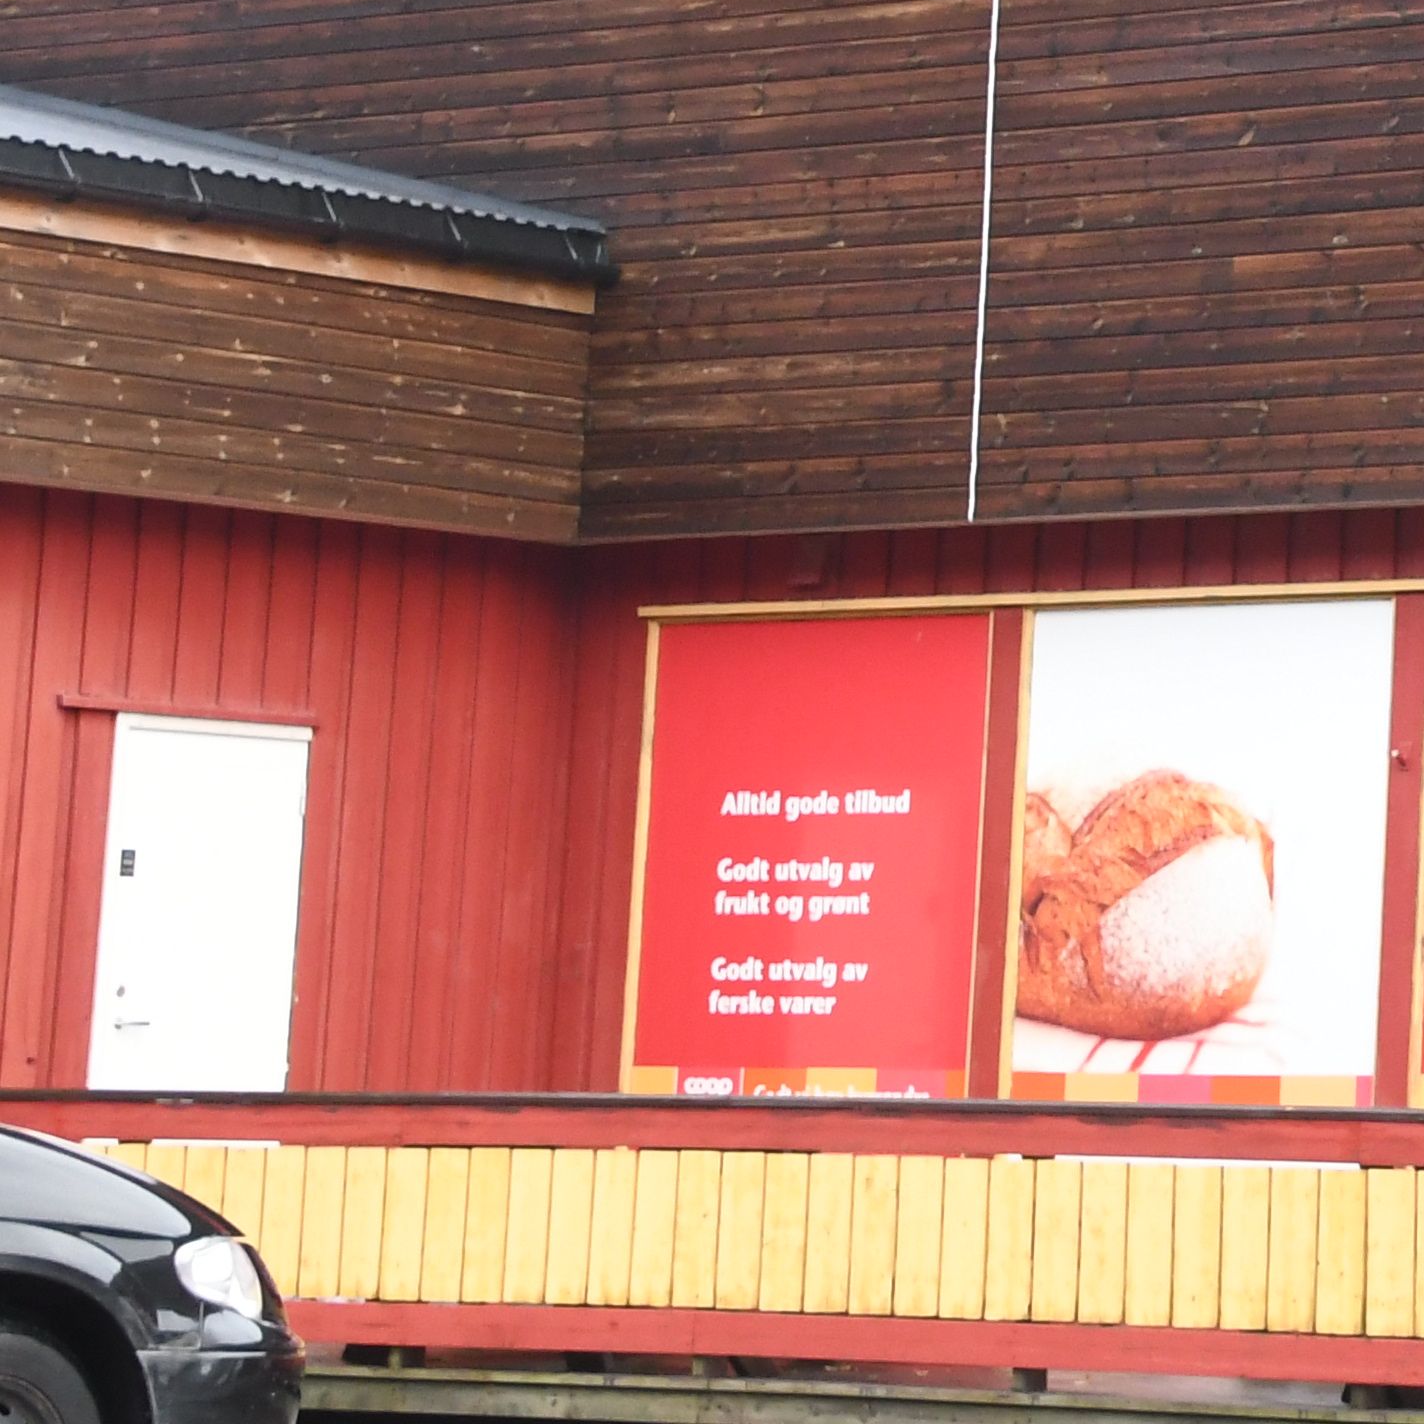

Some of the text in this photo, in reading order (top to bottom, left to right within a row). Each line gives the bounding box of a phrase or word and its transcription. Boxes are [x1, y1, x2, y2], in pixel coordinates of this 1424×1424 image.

[721, 789, 911, 822] Alltid gode tilbud
[717, 856, 875, 888] Godt utvalg av
[714, 890, 870, 921] frukt og grønt
[711, 956, 868, 988] Godt utvalg av
[708, 990, 836, 1014] ferske varer
